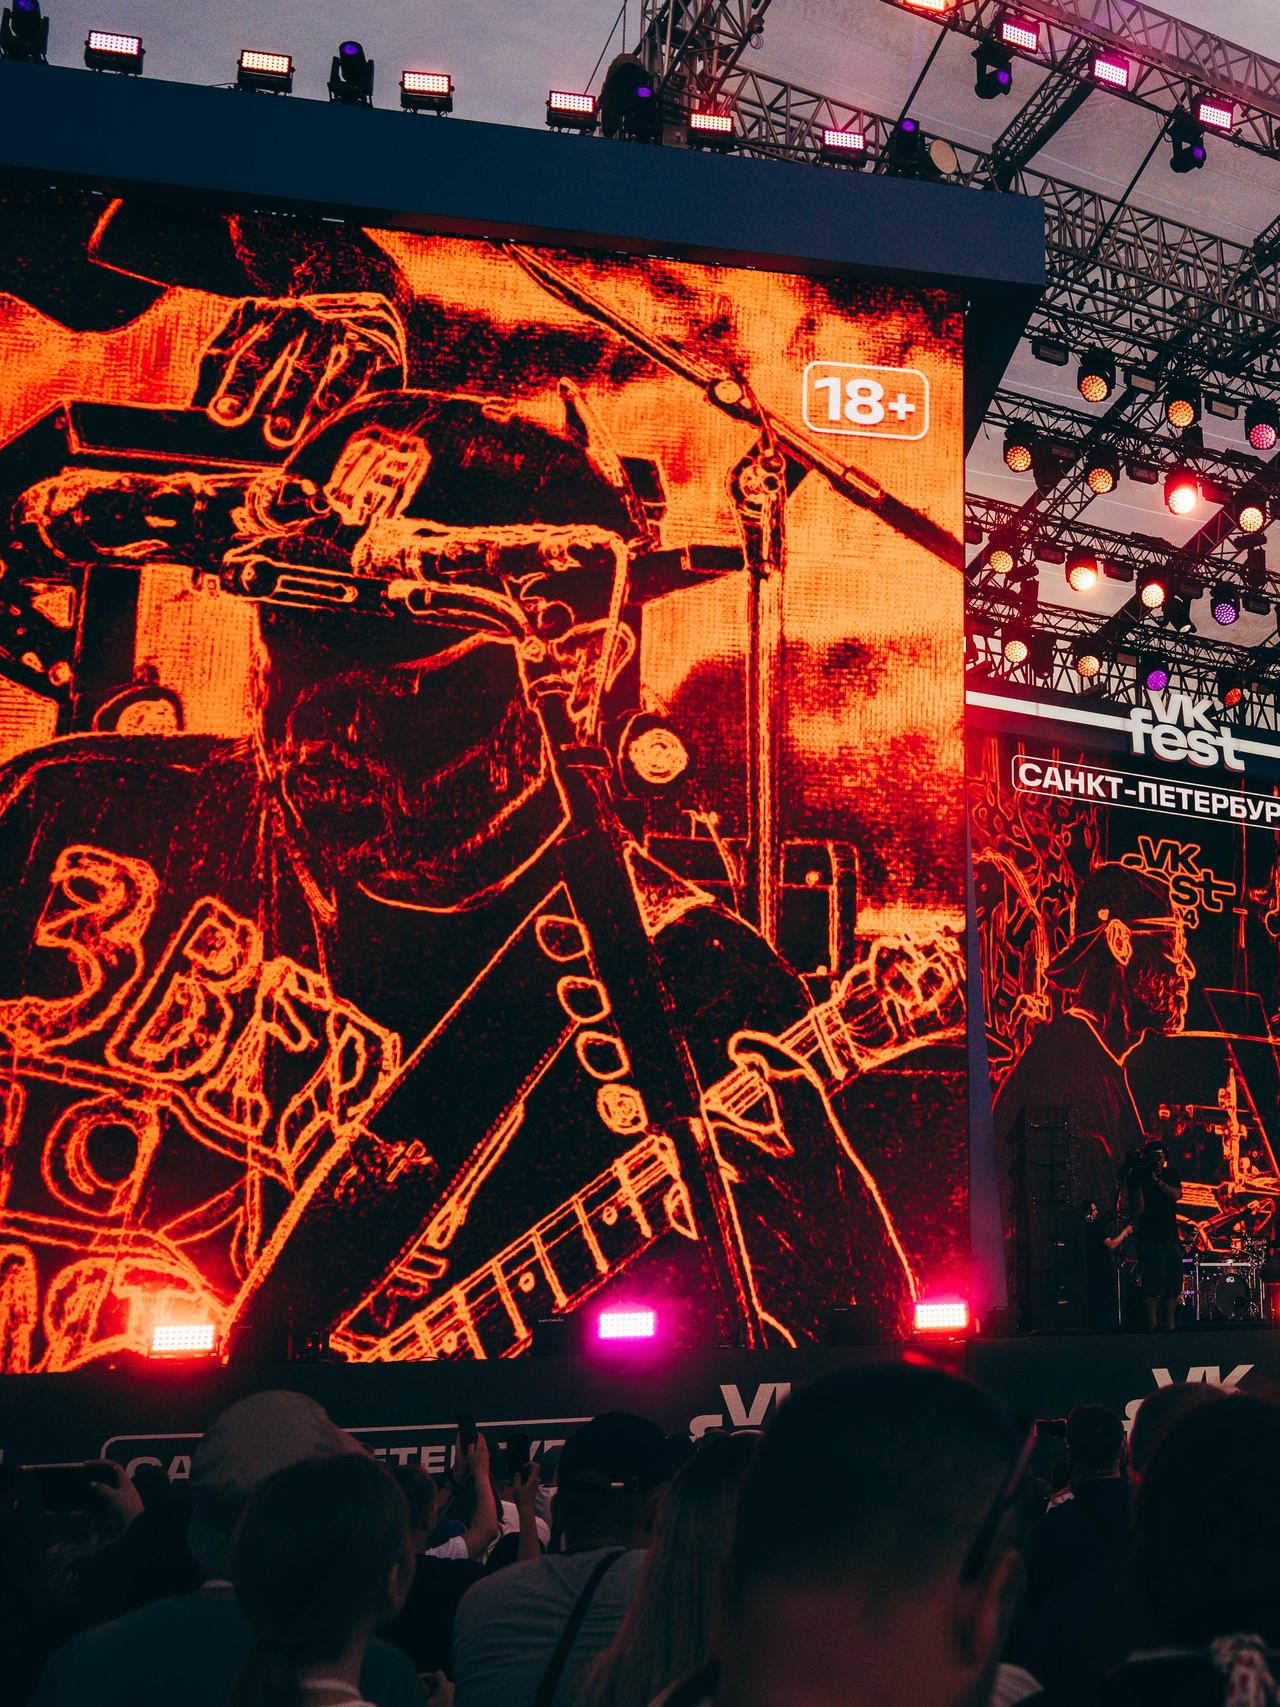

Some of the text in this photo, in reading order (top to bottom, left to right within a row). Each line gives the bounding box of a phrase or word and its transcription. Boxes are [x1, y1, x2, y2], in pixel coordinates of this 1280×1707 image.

[814, 377, 916, 425] 18+
[1150, 692, 1217, 731] VK
[1129, 708, 1245, 771] fest
[1137, 835, 1201, 877] VK
